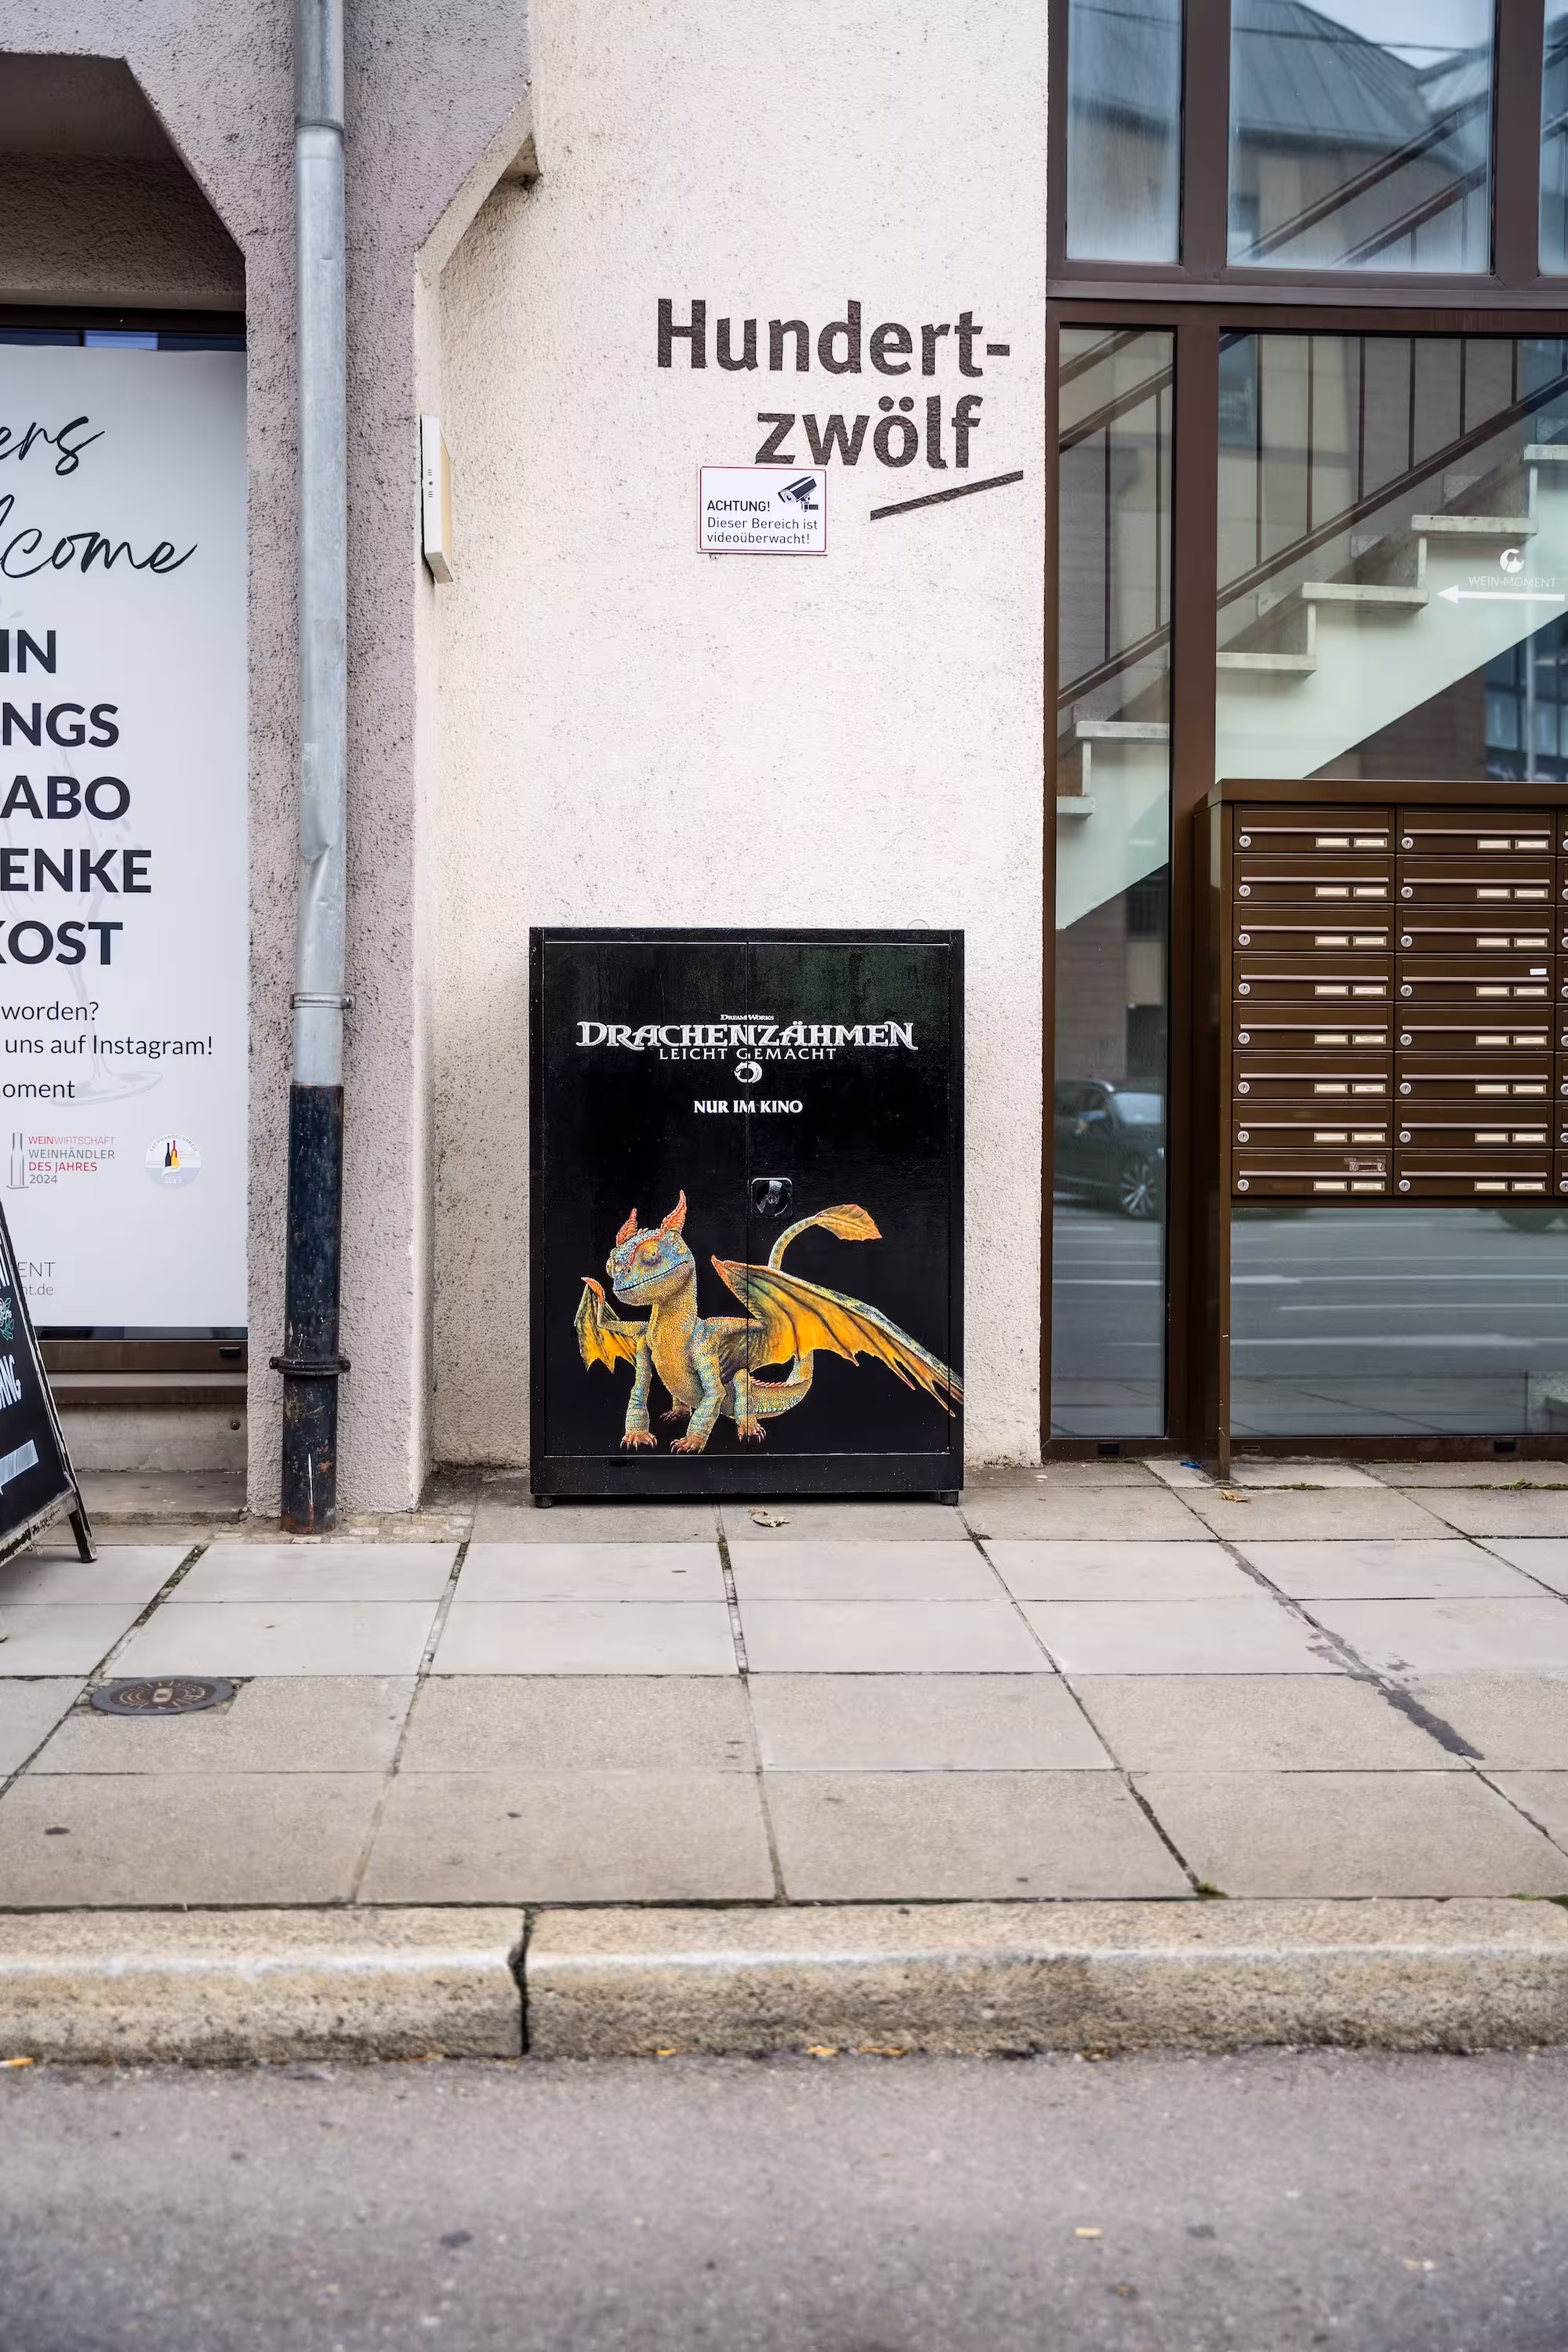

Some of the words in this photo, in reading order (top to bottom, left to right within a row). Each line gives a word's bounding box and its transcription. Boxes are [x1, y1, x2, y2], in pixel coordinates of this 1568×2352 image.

[658, 298, 1010, 377] Hundert-
[755, 394, 983, 470] zwölf
[707, 500, 770, 511] ACHTUNG!
[708, 517, 747, 528] Dieser
[752, 518, 799, 529] Bereich
[803, 519, 818, 530] ist
[707, 532, 810, 544] videoüberwacht!
[1468, 576, 1555, 588] WEIN-MOMENT
[2, 702, 119, 748] NGS
[0, 775, 130, 821] ABO
[0, 848, 151, 893] ENKE
[0, 920, 123, 965] OST
[1, 1001, 99, 1021] worden?
[576, 1021, 918, 1051] DRACHENZÄHMEN
[5, 1039, 44, 1054] uns
[51, 1034, 86, 1054] auf
[93, 1035, 212, 1058] Instagram!
[659, 1048, 728, 1060] LEICHT
[736, 1048, 837, 1060] GEMACHT
[2, 1080, 75, 1098] oment
[693, 1100, 729, 1114] NUR
[733, 1100, 756, 1114] IM
[760, 1100, 803, 1114] KINO
[28, 1136, 115, 1145] WEINWIRTSCHAFT
[28, 1148, 115, 1160] WEINHÄNDLER
[29, 1162, 52, 1171] DES
[55, 1162, 98, 1174] JAHRES
[29, 1174, 58, 1184] 2024
